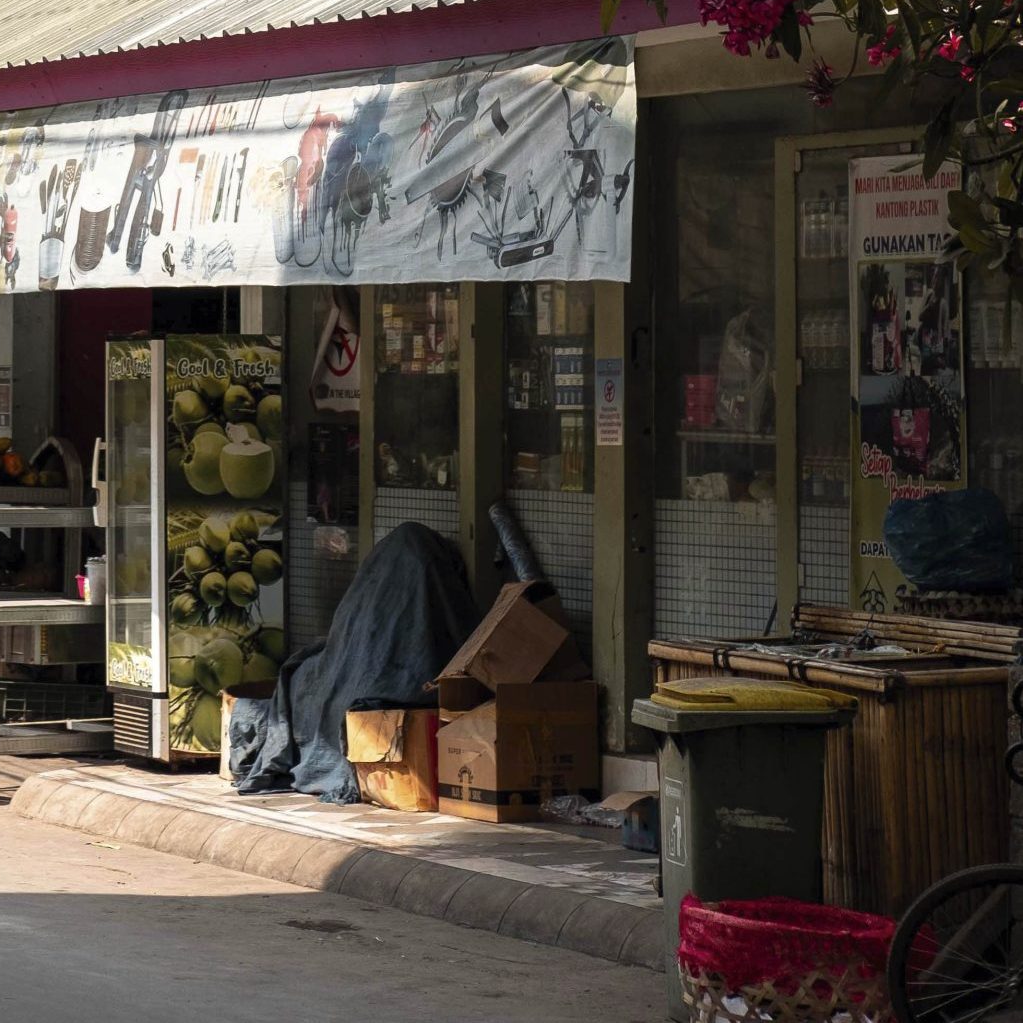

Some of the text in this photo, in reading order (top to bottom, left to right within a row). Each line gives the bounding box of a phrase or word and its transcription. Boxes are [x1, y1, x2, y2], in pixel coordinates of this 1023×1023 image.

[855, 176, 874, 193] MARI
[875, 176, 891, 193] KITA
[892, 174, 926, 192] MENJAGA
[875, 199, 939, 219] KANTONG PLASTIK
[863, 233, 925, 254] GUNAKAN
[176, 357, 276, 379] Cool & Fresh
[861, 441, 892, 487] Setiap
